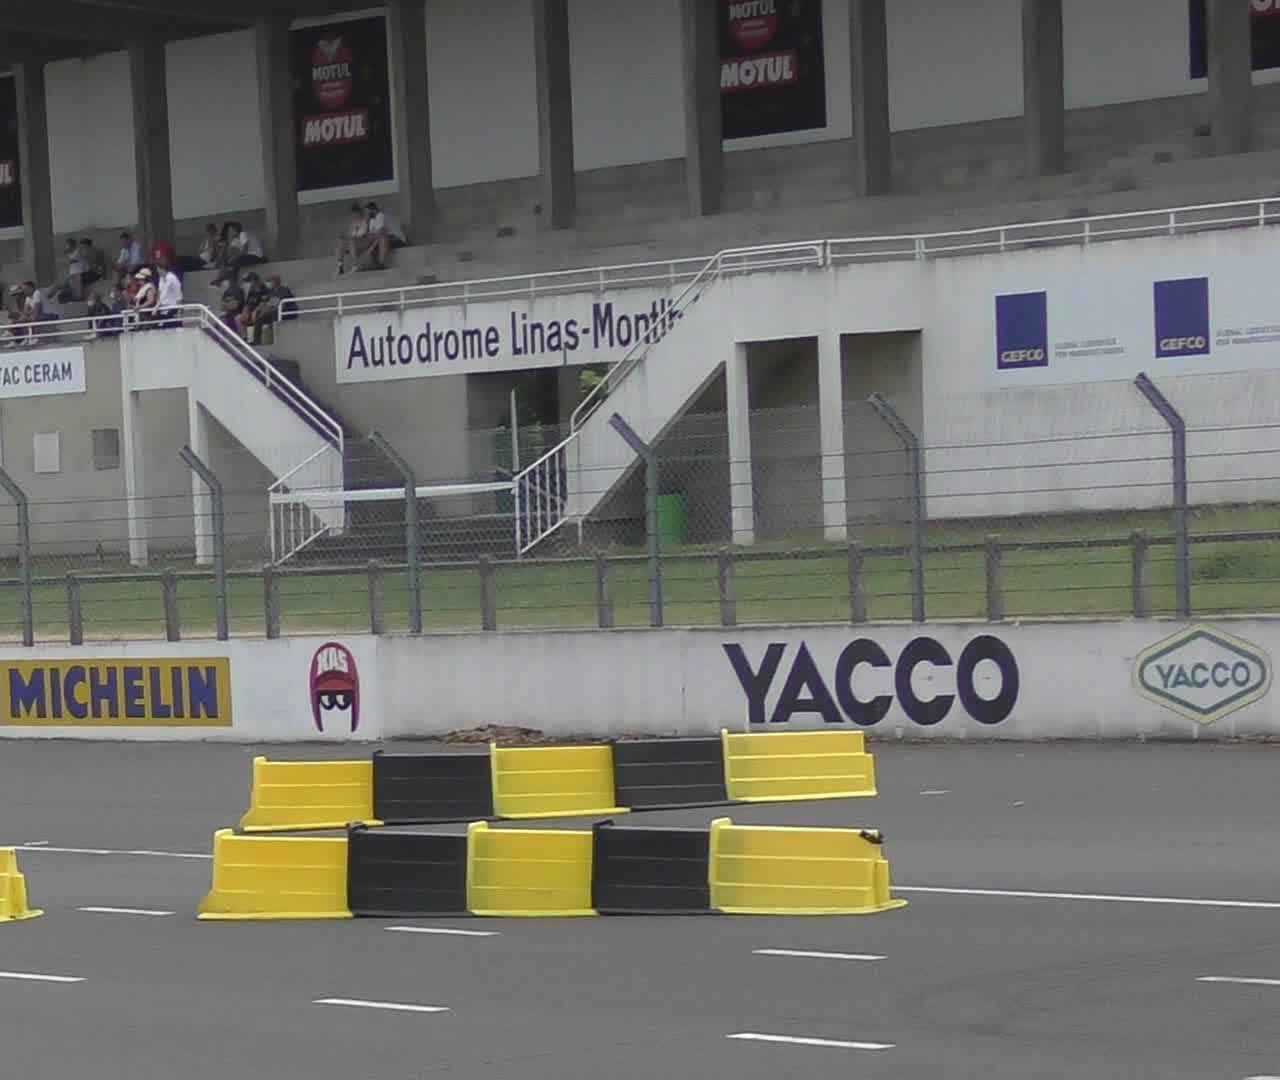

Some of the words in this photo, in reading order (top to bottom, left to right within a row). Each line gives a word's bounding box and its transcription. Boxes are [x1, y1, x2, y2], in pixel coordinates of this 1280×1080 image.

[311, 62, 351, 80] MOTUL
[720, 55, 793, 88] MOTUL
[304, 113, 366, 143] MOTUL
[347, 321, 500, 369] Autodrome
[1001, 348, 1044, 363] GEFCO
[1160, 336, 1206, 351] GEFCO
[23, 361, 73, 384] CERAM
[722, 635, 1020, 726] YACCO
[1155, 661, 1251, 688] YACCO
[8, 664, 220, 719] MICHELIN
